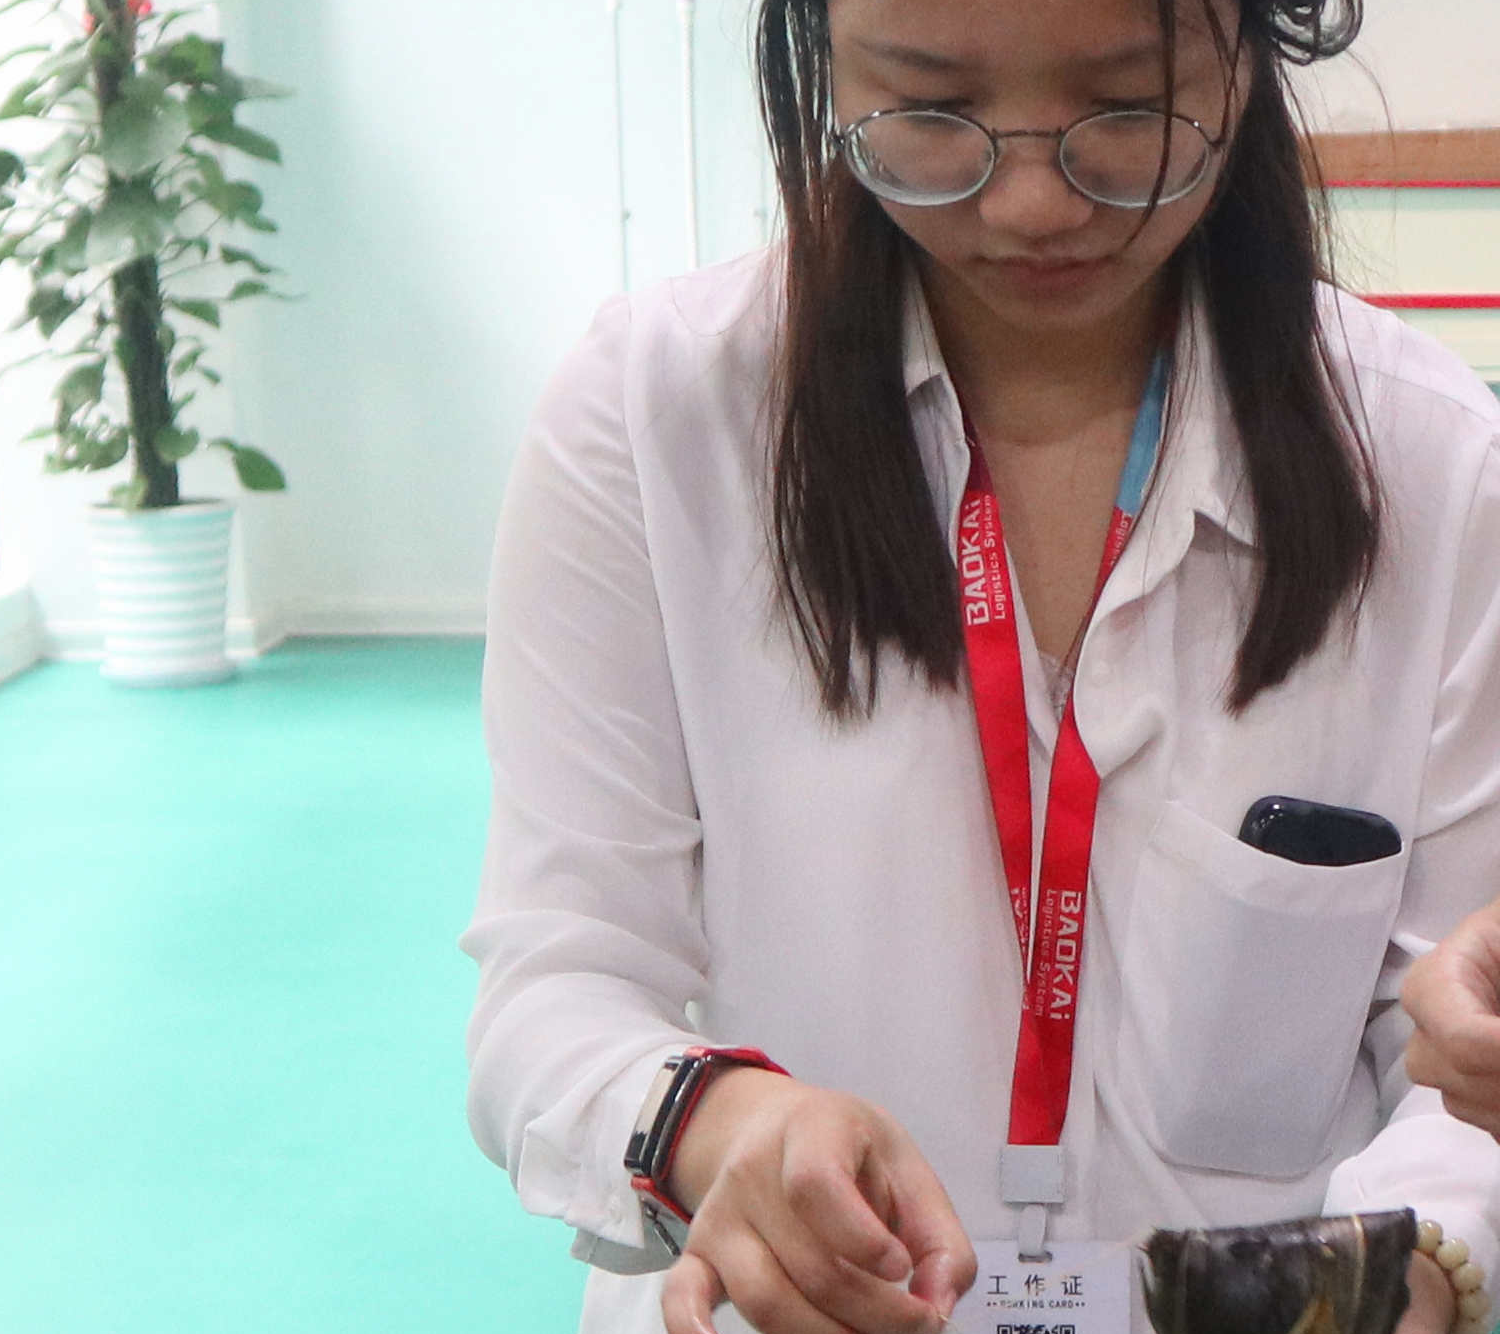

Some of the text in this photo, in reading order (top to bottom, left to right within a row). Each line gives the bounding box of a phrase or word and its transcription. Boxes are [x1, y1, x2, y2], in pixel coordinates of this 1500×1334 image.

[984, 494, 1006, 620] Logistics System
[1041, 888, 1058, 956] Logistics
[987, 1274, 1083, 1297] 工作证
